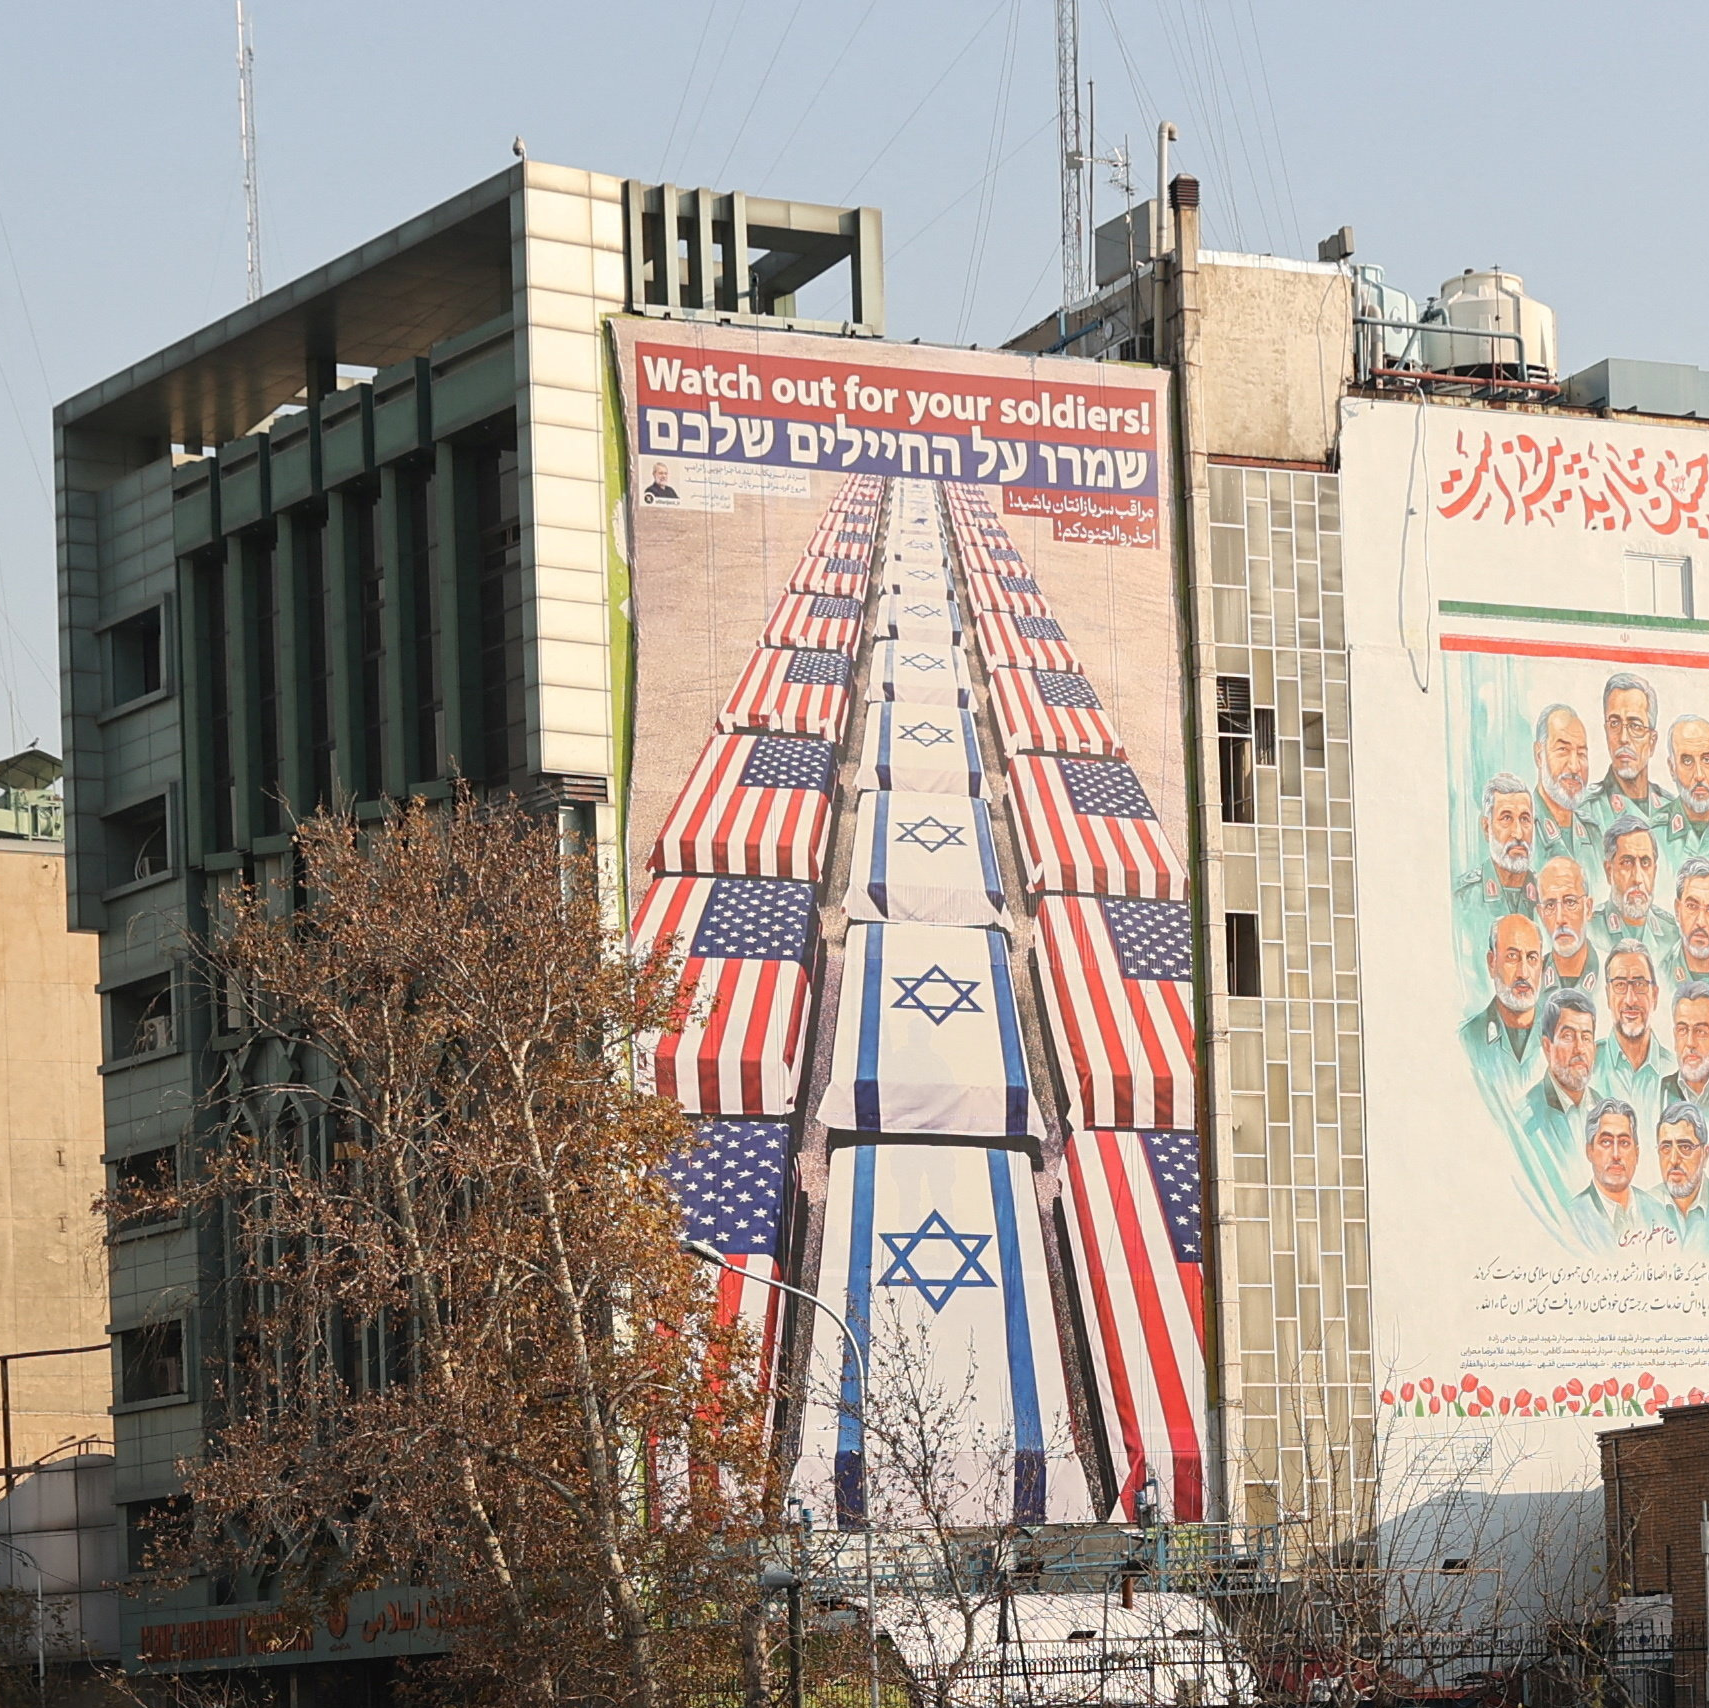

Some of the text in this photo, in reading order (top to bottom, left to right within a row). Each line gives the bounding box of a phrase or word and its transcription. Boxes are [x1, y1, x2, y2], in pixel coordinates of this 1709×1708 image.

[642, 355, 1151, 436] Watch out for your soldiers!
[645, 401, 1149, 489] שמרו על החיילים שלכם
[1008, 491, 1154, 522] مراقب سربازانتان باشید!
[1618, 1229, 1647, 1247] رهبری
[1661, 1227, 1677, 1252] مقام
[1473, 1255, 1501, 1281] کردند
[1492, 1266, 1523, 1281] خدمت
[1528, 1266, 1552, 1284] اسلامی
[1552, 1266, 1582, 1285] جمهوری
[1581, 1267, 1601, 1284] برای
[1601, 1267, 1620, 1284] بودند
[1548, 1292, 1582, 1315] دریافت
[1583, 1299, 1589, 1311] را
[1590, 1292, 1619, 1313] خودشان
[1650, 1295, 1682, 1310] خدمات
[1682, 1290, 1707, 1317] پاداش
[361, 1598, 421, 1643] اسلامی
